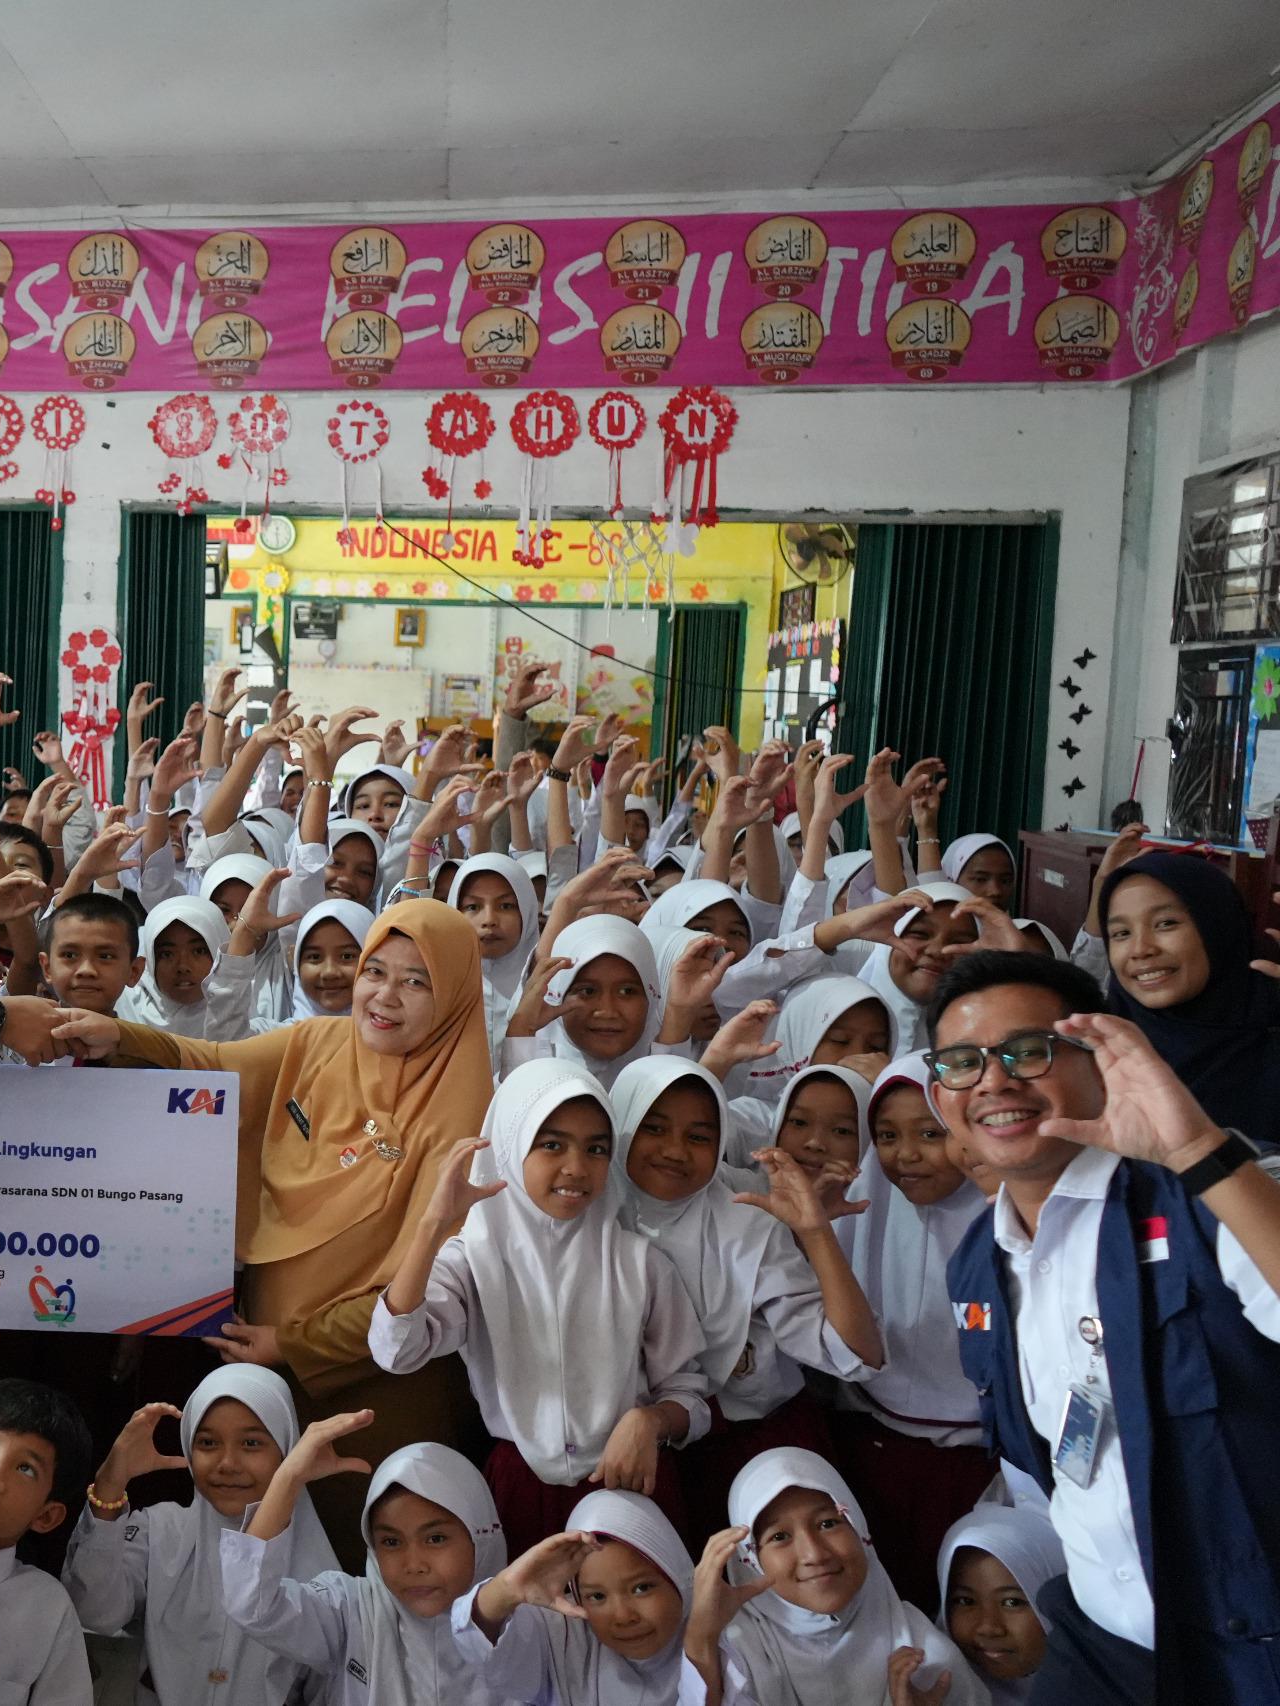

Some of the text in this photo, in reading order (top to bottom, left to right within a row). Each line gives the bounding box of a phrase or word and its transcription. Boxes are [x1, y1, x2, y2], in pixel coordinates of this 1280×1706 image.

[926, 282, 938, 292] 19
[1075, 277, 1087, 288] 18
[637, 288, 649, 298] 21
[778, 285, 791, 296] 20
[361, 294, 373, 303] 23
[497, 291, 510, 301] 22
[96, 297, 109, 307] 25
[224, 297, 237, 306] 24
[357, 375, 369, 385] 73
[494, 374, 506, 383] 72
[634, 372, 646, 382] 71
[774, 371, 787, 380] 70
[93, 377, 105, 387] 75
[221, 376, 233, 386] 74
[168, 1087, 226, 1115] KAI
[51, 1187, 78, 1198] SDN
[81, 1188, 94, 1198] 01
[97, 1189, 136, 1201] Bungo
[139, 1190, 184, 1203] Pasang
[951, 1302, 992, 1331] KAI
